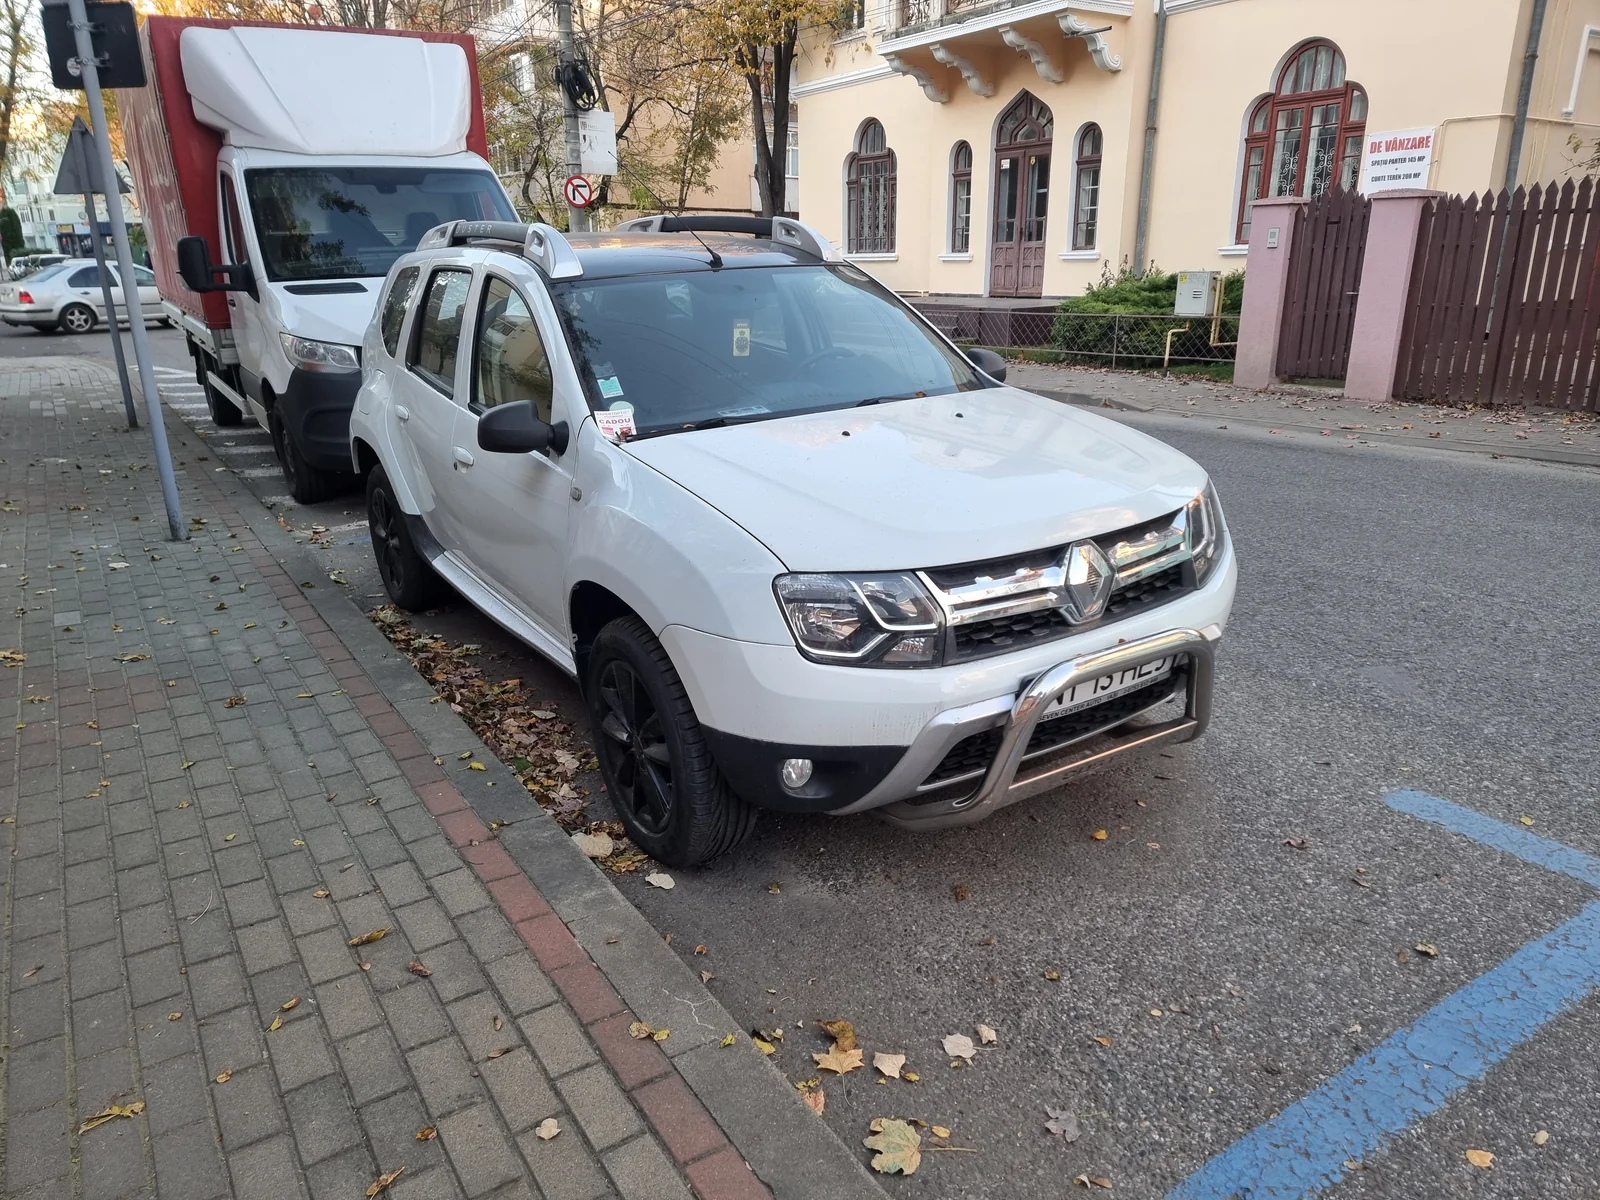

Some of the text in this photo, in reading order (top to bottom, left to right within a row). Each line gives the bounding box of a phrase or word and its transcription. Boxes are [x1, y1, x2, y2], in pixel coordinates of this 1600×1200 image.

[1370, 136, 1431, 154] DE VÂNZARE
[455, 224, 493, 234] DUSTER
[1060, 703, 1085, 715] CENTER
[1086, 697, 1102, 707] AUTO
